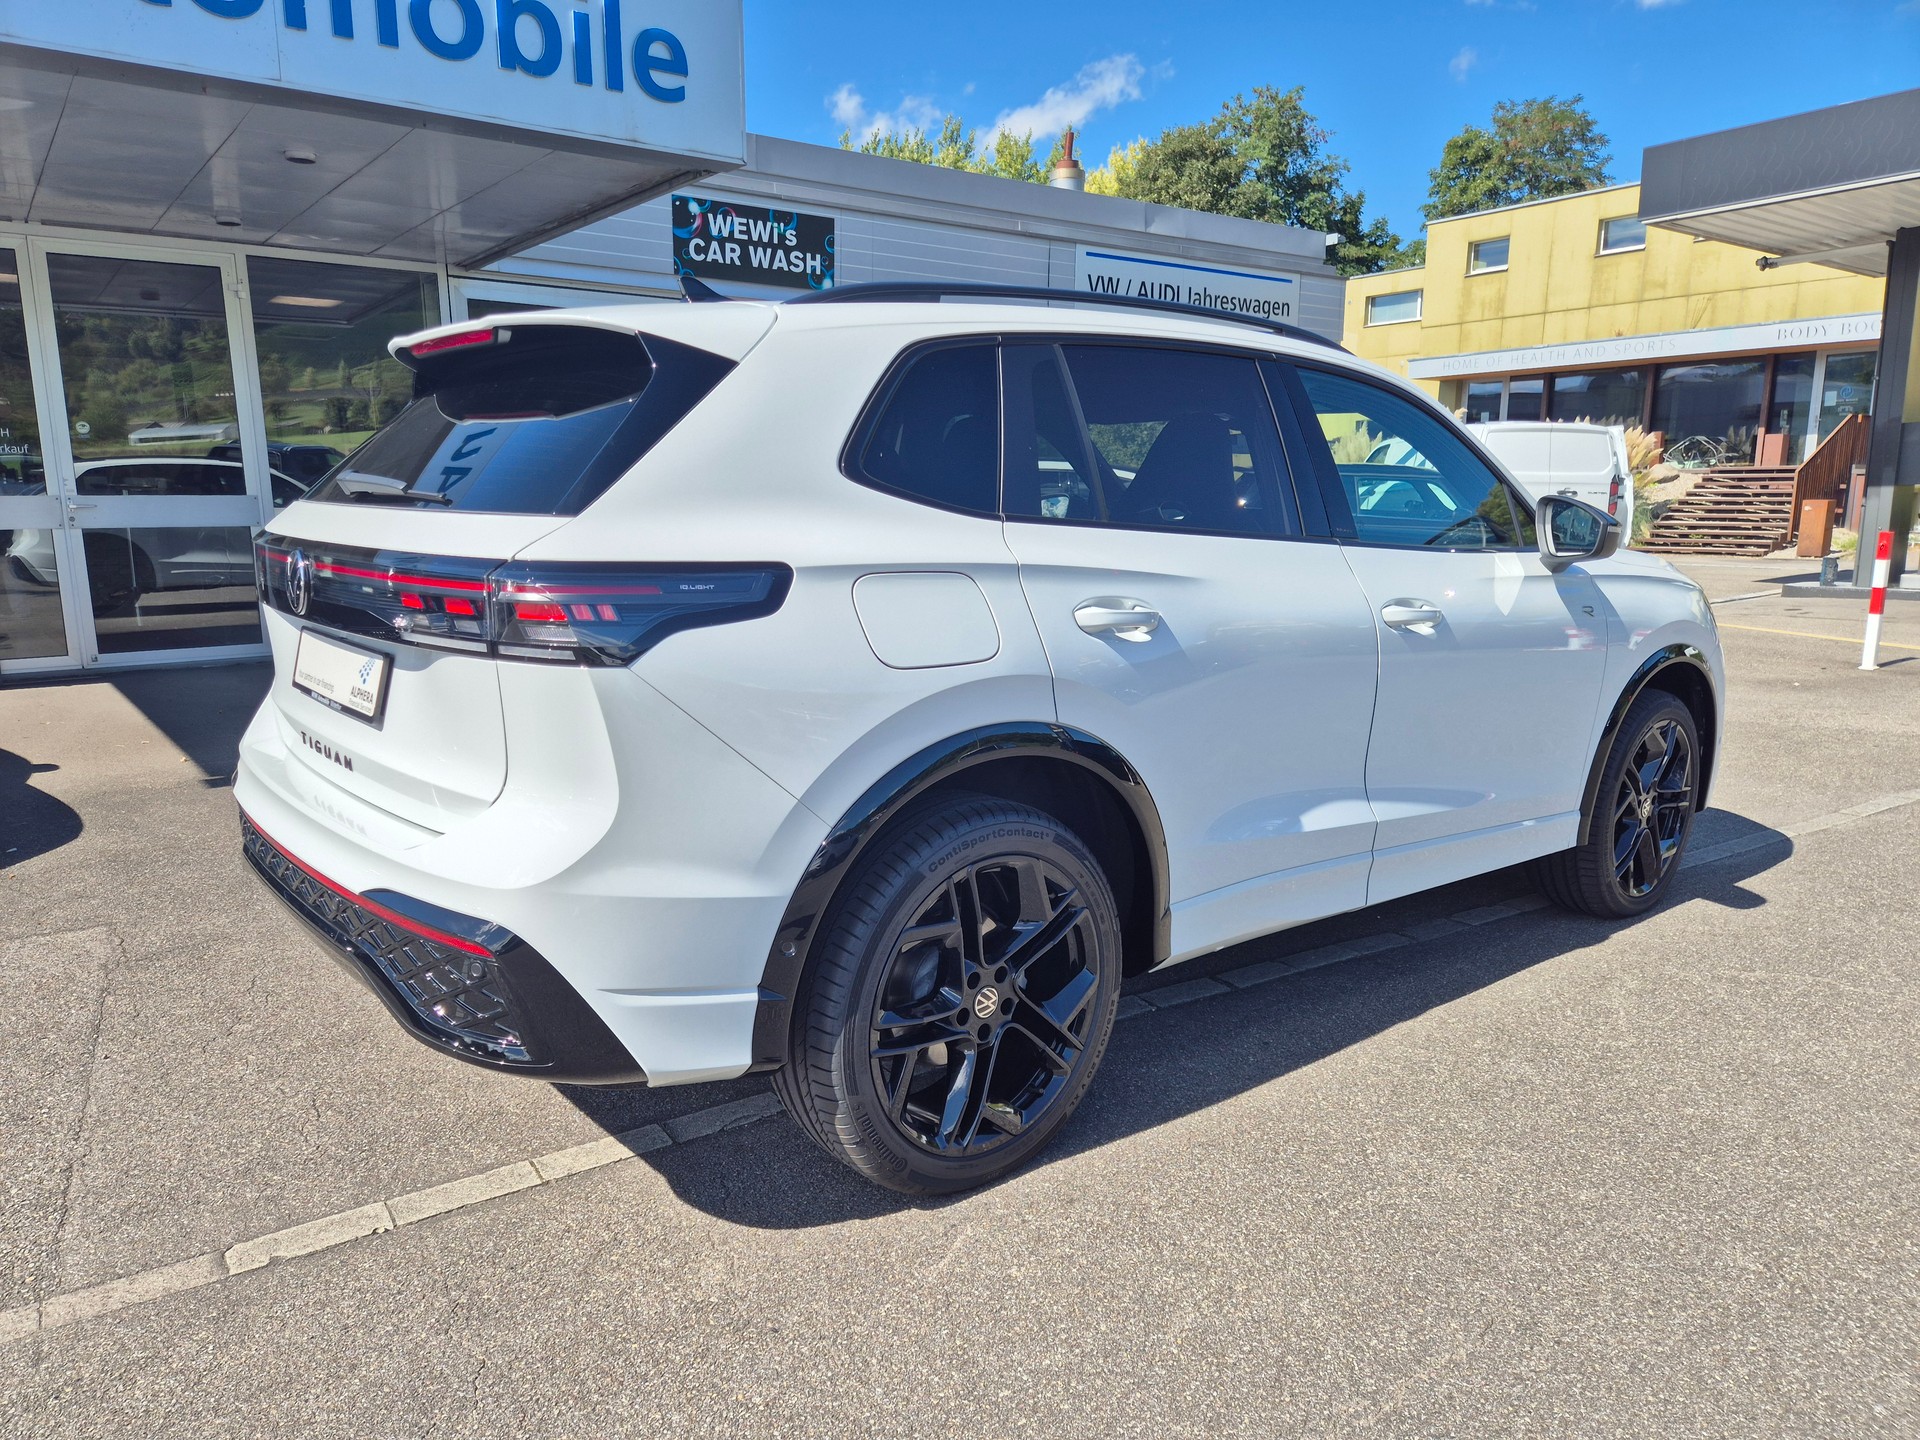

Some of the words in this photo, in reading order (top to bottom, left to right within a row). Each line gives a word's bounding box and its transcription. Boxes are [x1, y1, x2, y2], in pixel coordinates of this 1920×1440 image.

[139, 0, 689, 103] obile
[689, 238, 742, 266] CAR
[748, 245, 821, 275] WASH
[1087, 273, 1121, 295] VW
[1137, 280, 1181, 302] AUDI
[1187, 286, 1290, 319] Jahreswagen
[1777, 324, 1833, 340] BODY
[1443, 358, 1480, 371] HOME
[1486, 355, 1504, 367] OF
[1510, 349, 1566, 365] HEALTH
[1574, 346, 1606, 359] AND
[1614, 338, 1676, 355] SPORTS
[350, 685, 374, 704] ALPHERA
[300, 730, 354, 772] TIGUAN
[857, 1112, 908, 1173] Continental
